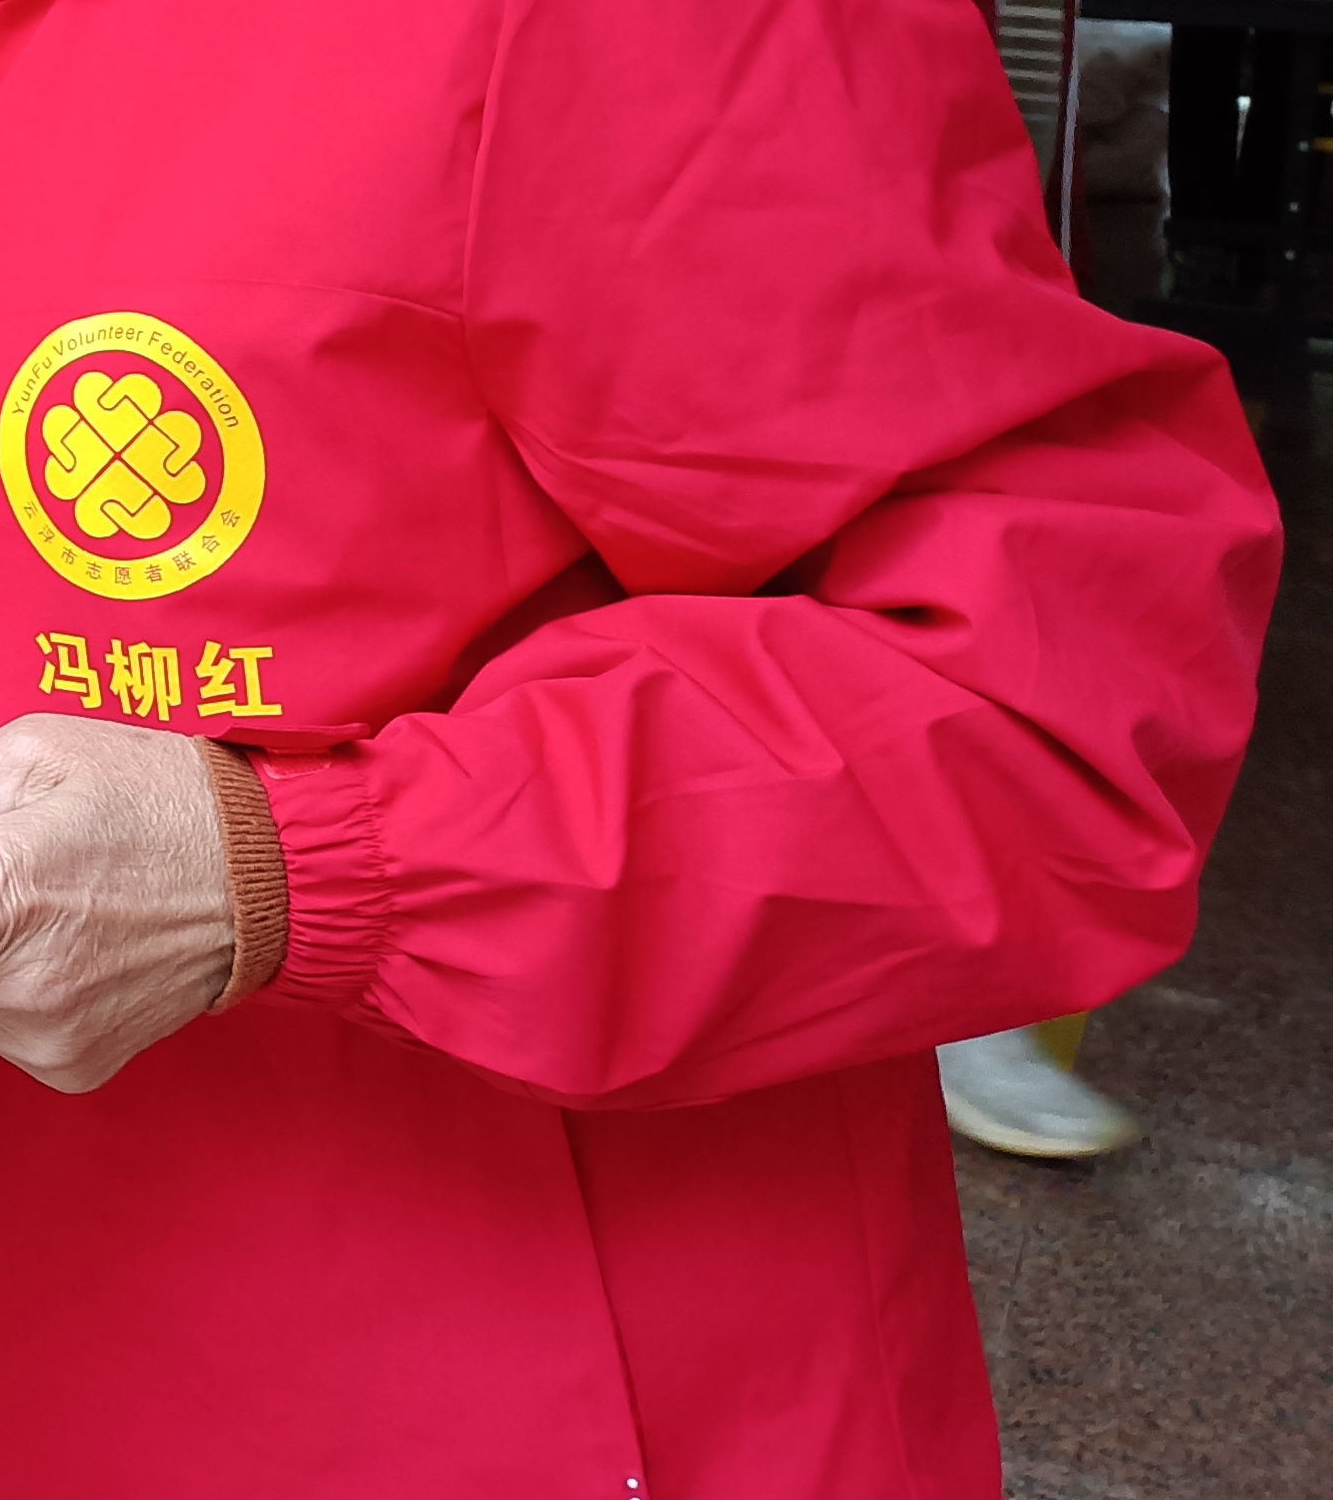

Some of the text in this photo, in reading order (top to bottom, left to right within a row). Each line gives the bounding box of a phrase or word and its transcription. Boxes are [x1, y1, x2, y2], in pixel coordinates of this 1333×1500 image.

[11, 325, 240, 429] YunFu Volunteer Federation
[23, 500, 242, 585] 云浮市志愿者联合会
[35, 631, 283, 721] 冯柳红
